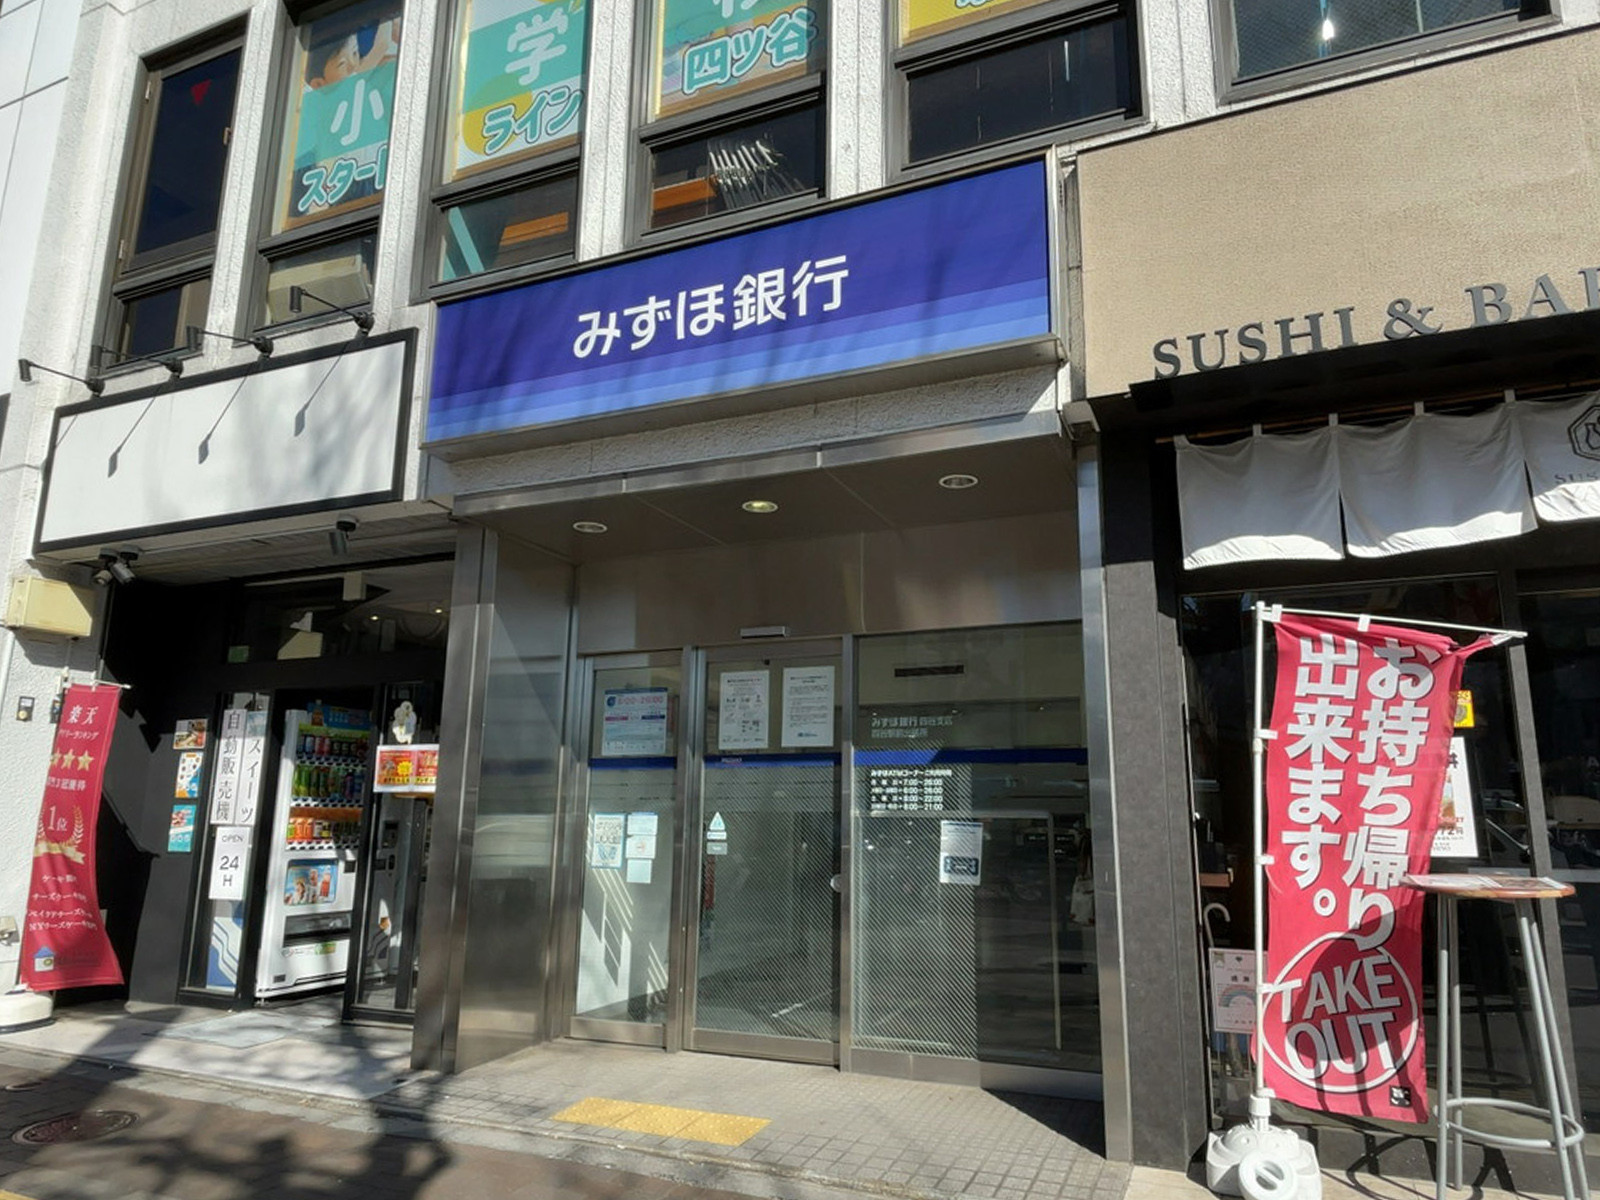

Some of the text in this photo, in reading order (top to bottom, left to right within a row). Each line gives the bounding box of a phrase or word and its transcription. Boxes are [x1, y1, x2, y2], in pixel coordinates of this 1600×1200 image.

[505, 7, 569, 86] 学
[683, 8, 819, 94] 四ツ谷
[330, 79, 384, 145] 小
[482, 86, 583, 155] ライン
[572, 254, 850, 360] みずほ銀行
[1153, 306, 1356, 380] SUSHI
[1383, 298, 1443, 340] &
[66, 704, 99, 726] 楽天
[216, 712, 240, 821] 自動販売機
[240, 738, 262, 824] スイーツ
[1284, 636, 1360, 917] 出来ます。
[1342, 637, 1441, 949] お持ち帰り
[219, 855, 240, 871] 24
[221, 834, 244, 843] OPEN
[222, 874, 233, 887] H
[1263, 953, 1400, 1023] TAKE
[1285, 1012, 1399, 1080] OUT
